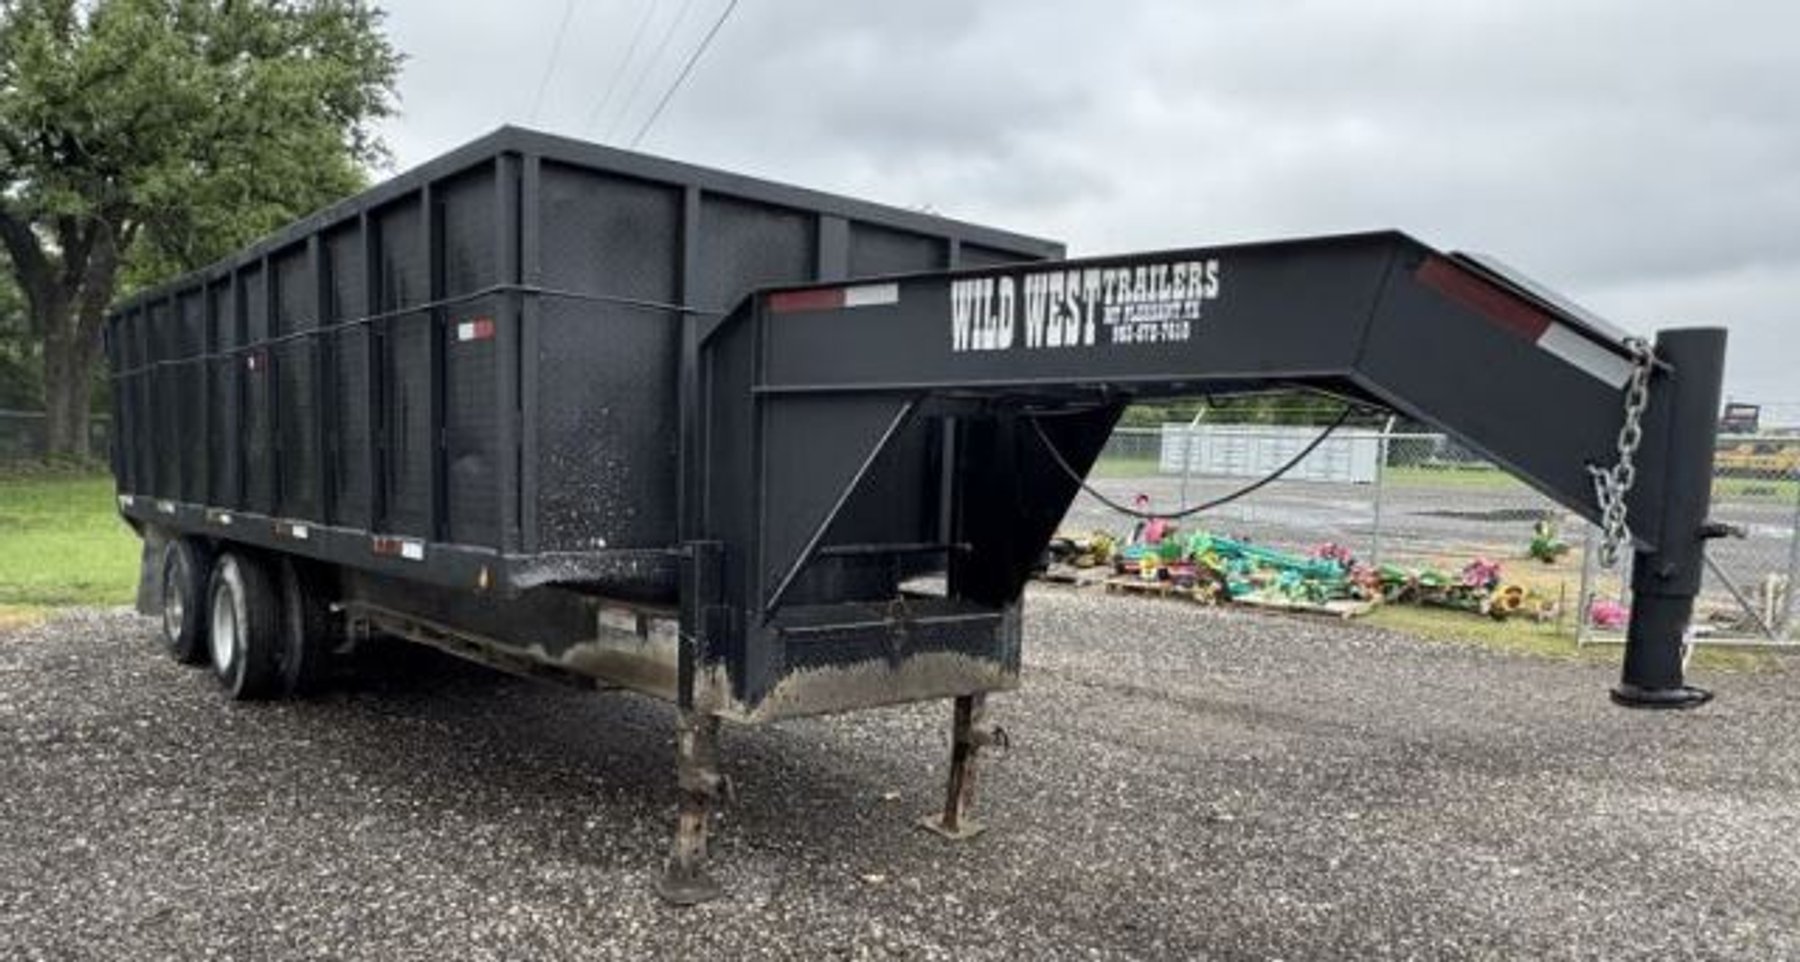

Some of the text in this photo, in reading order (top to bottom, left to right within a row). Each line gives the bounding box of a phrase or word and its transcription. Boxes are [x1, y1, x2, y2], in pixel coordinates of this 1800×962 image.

[952, 259, 1219, 350] WILD WEST TRAILERS
